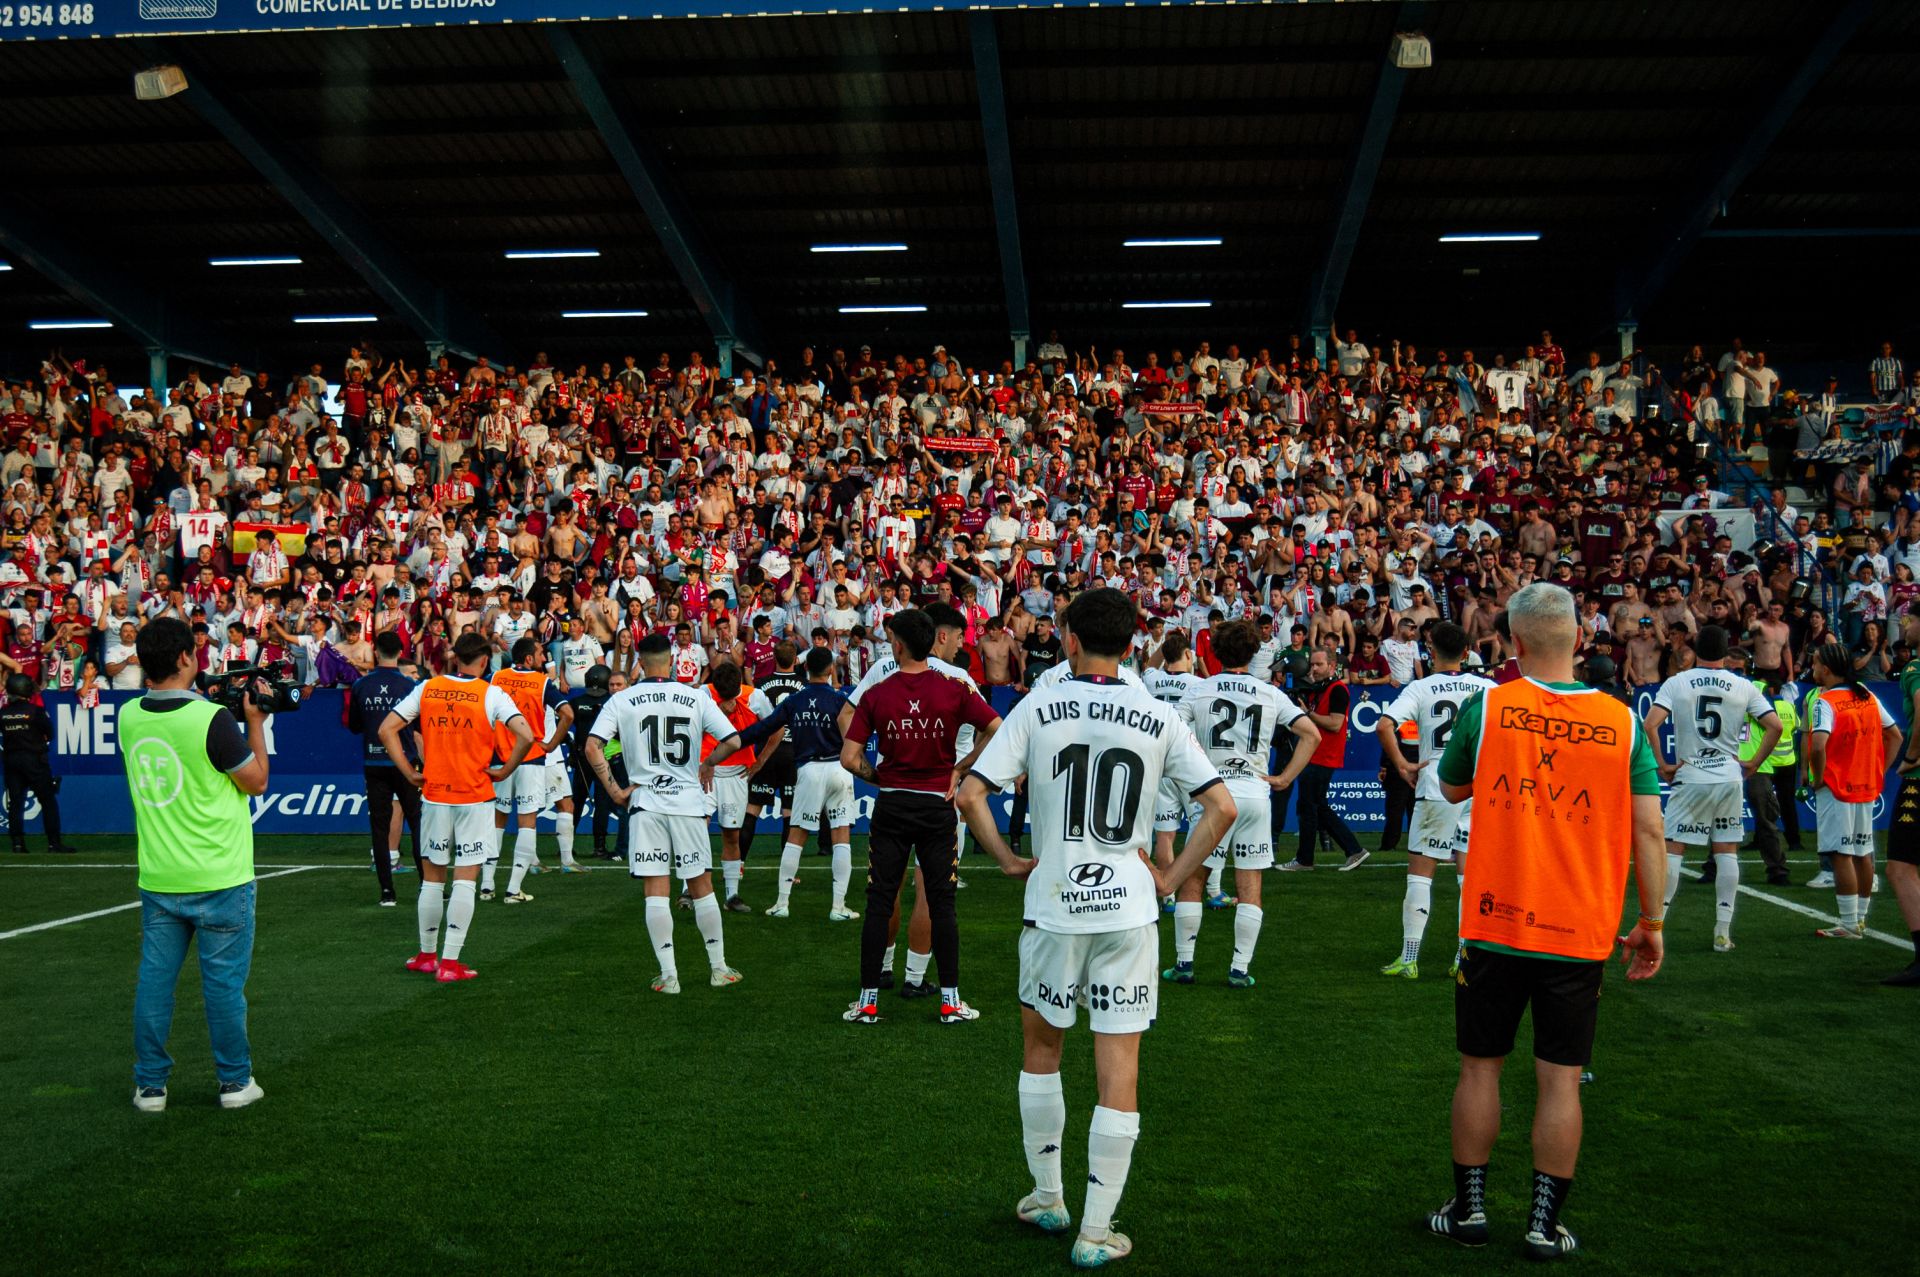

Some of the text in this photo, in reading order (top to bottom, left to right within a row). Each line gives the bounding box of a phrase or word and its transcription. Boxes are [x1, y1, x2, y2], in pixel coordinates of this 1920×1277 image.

[256, 0, 371, 14] COMERCIAL
[0, 3, 94, 27] 2 954 848
[1504, 376, 1514, 393] 4
[189, 519, 209, 538] 14
[499, 678, 540, 690] Kappa
[1155, 680, 1187, 692] ALVARO
[1217, 681, 1257, 696] ARTOLA
[1431, 682, 1486, 695] PASTORIZ
[1689, 676, 1732, 692] FORNOS
[425, 688, 480, 703] Kappa
[628, 692, 696, 709] VICTOR RUIZ
[428, 716, 473, 729] ARVA
[794, 711, 831, 722] ARVA
[1036, 701, 1164, 739] LUIS CHACÓN
[1696, 695, 1723, 741] 5
[887, 717, 945, 731] ARVA
[1209, 697, 1263, 755] 21
[1500, 706, 1617, 746] Kappa
[639, 714, 691, 767] 15
[887, 731, 945, 740] HOTELES
[751, 783, 774, 795] RIAÑO
[1053, 743, 1145, 845] 10
[1340, 791, 1362, 799] 409
[1366, 791, 1387, 799] 695
[1493, 774, 1592, 808] ARVA
[1328, 803, 1346, 811] ÓN
[1489, 797, 1590, 825] HOTELES
[803, 812, 819, 824] RIAÑ
[1344, 813, 1386, 821] 409 84
[1728, 816, 1743, 828] CJ
[1677, 821, 1711, 835] RIAÑO
[463, 841, 483, 854] CJR
[1248, 843, 1270, 855] CJR
[634, 848, 669, 863] RIAÑO
[682, 851, 700, 865] CJR
[1061, 887, 1127, 903] HYUNDAI
[1069, 902, 1121, 914] Lemauto
[1113, 985, 1150, 1006] CJR
